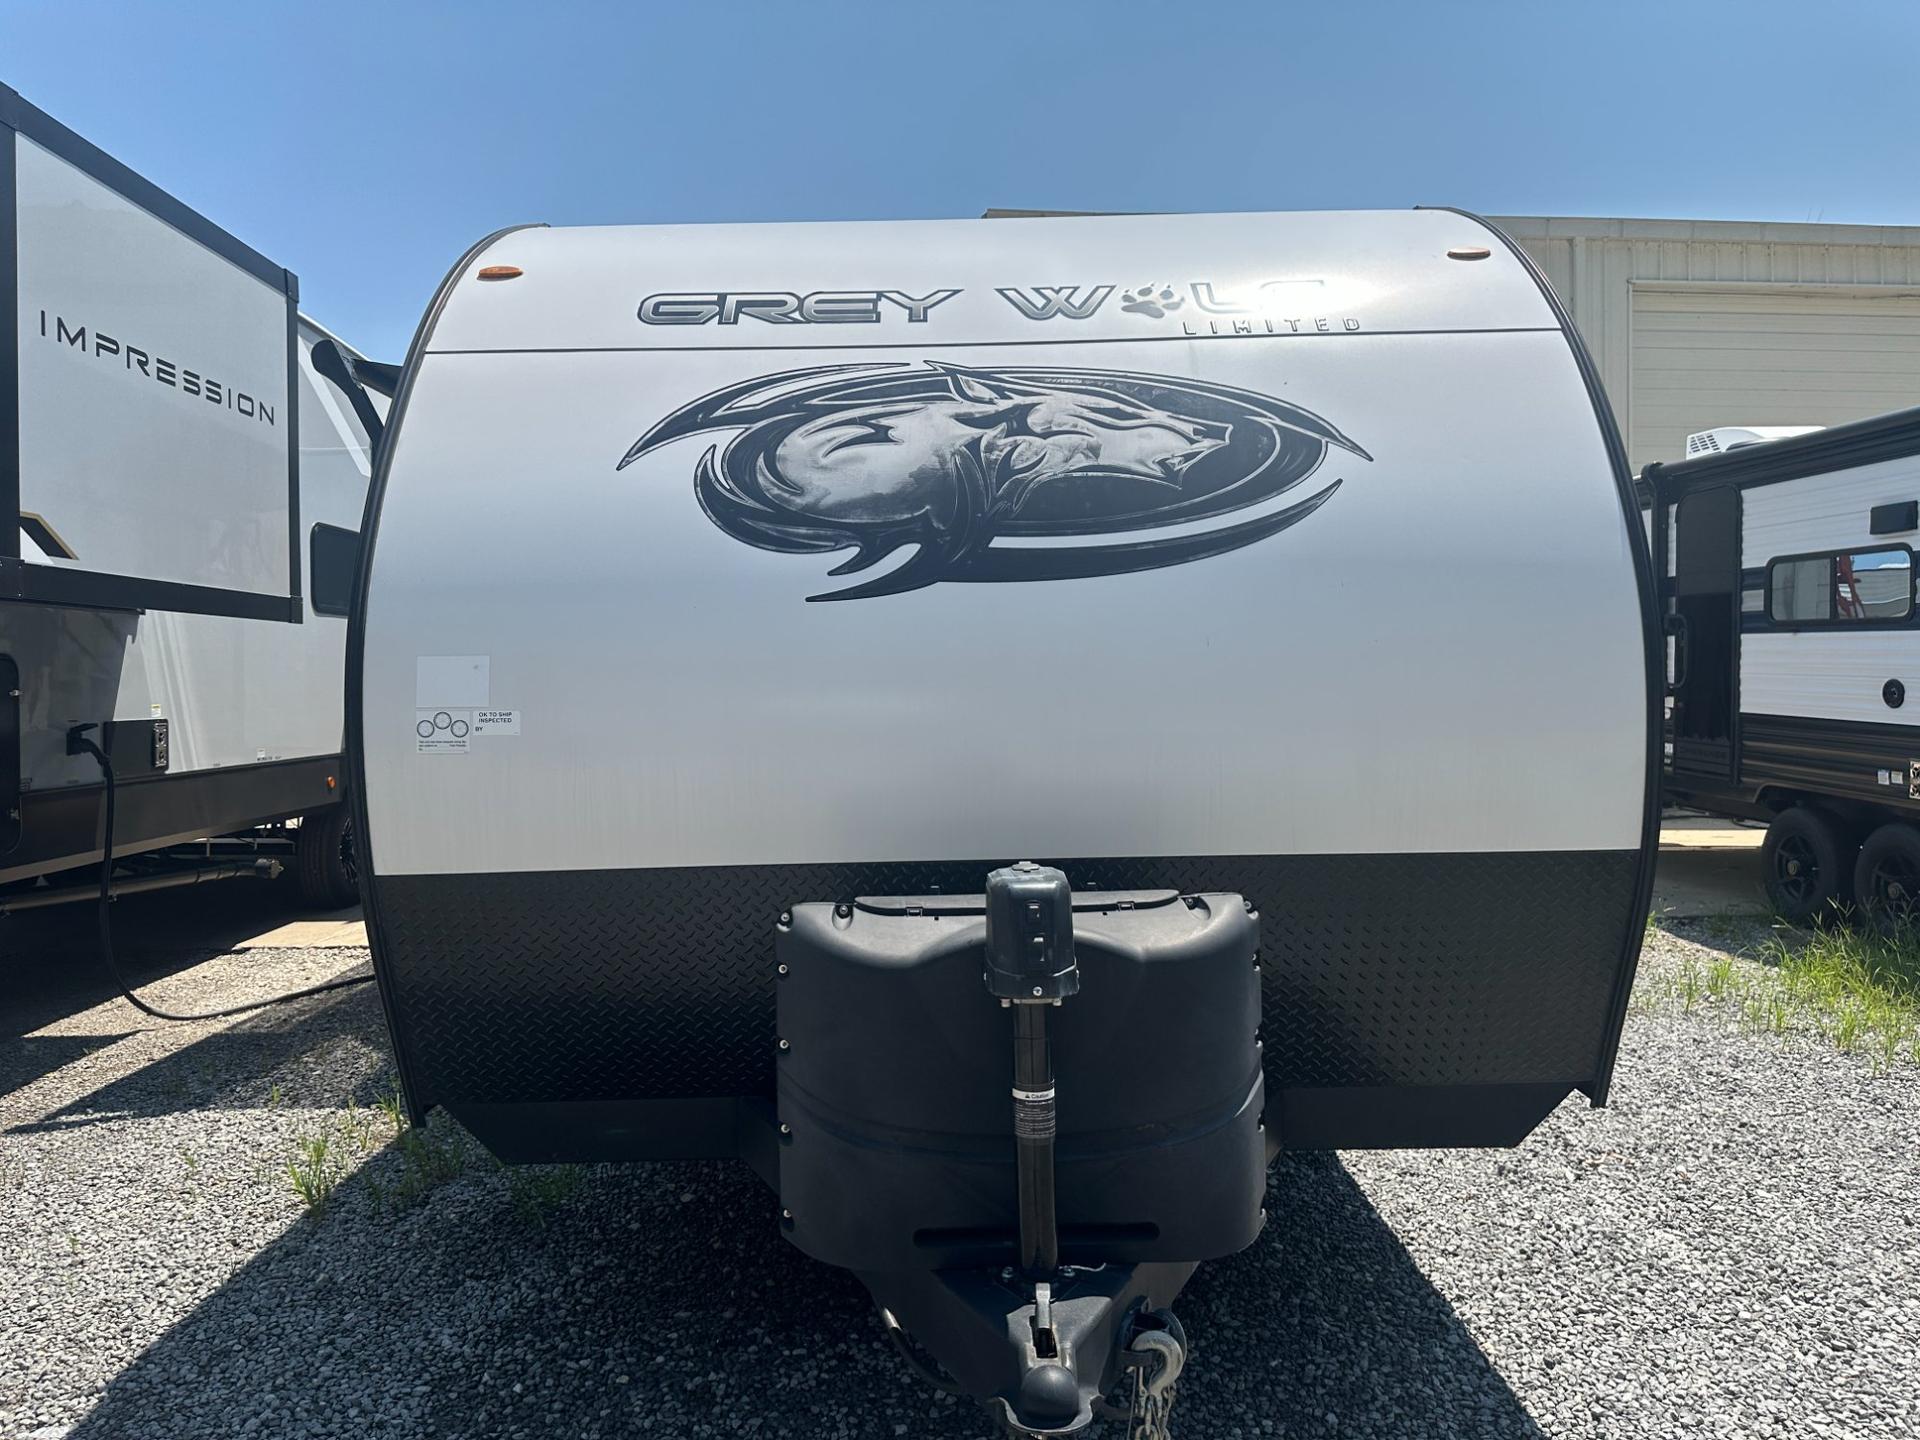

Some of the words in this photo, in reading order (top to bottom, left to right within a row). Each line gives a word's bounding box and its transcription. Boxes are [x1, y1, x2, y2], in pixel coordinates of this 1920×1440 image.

[637, 288, 965, 326] GREY
[994, 280, 1325, 321] WOL
[1182, 317, 1361, 336] LIMITED
[40, 310, 275, 426] IMPRESSION
